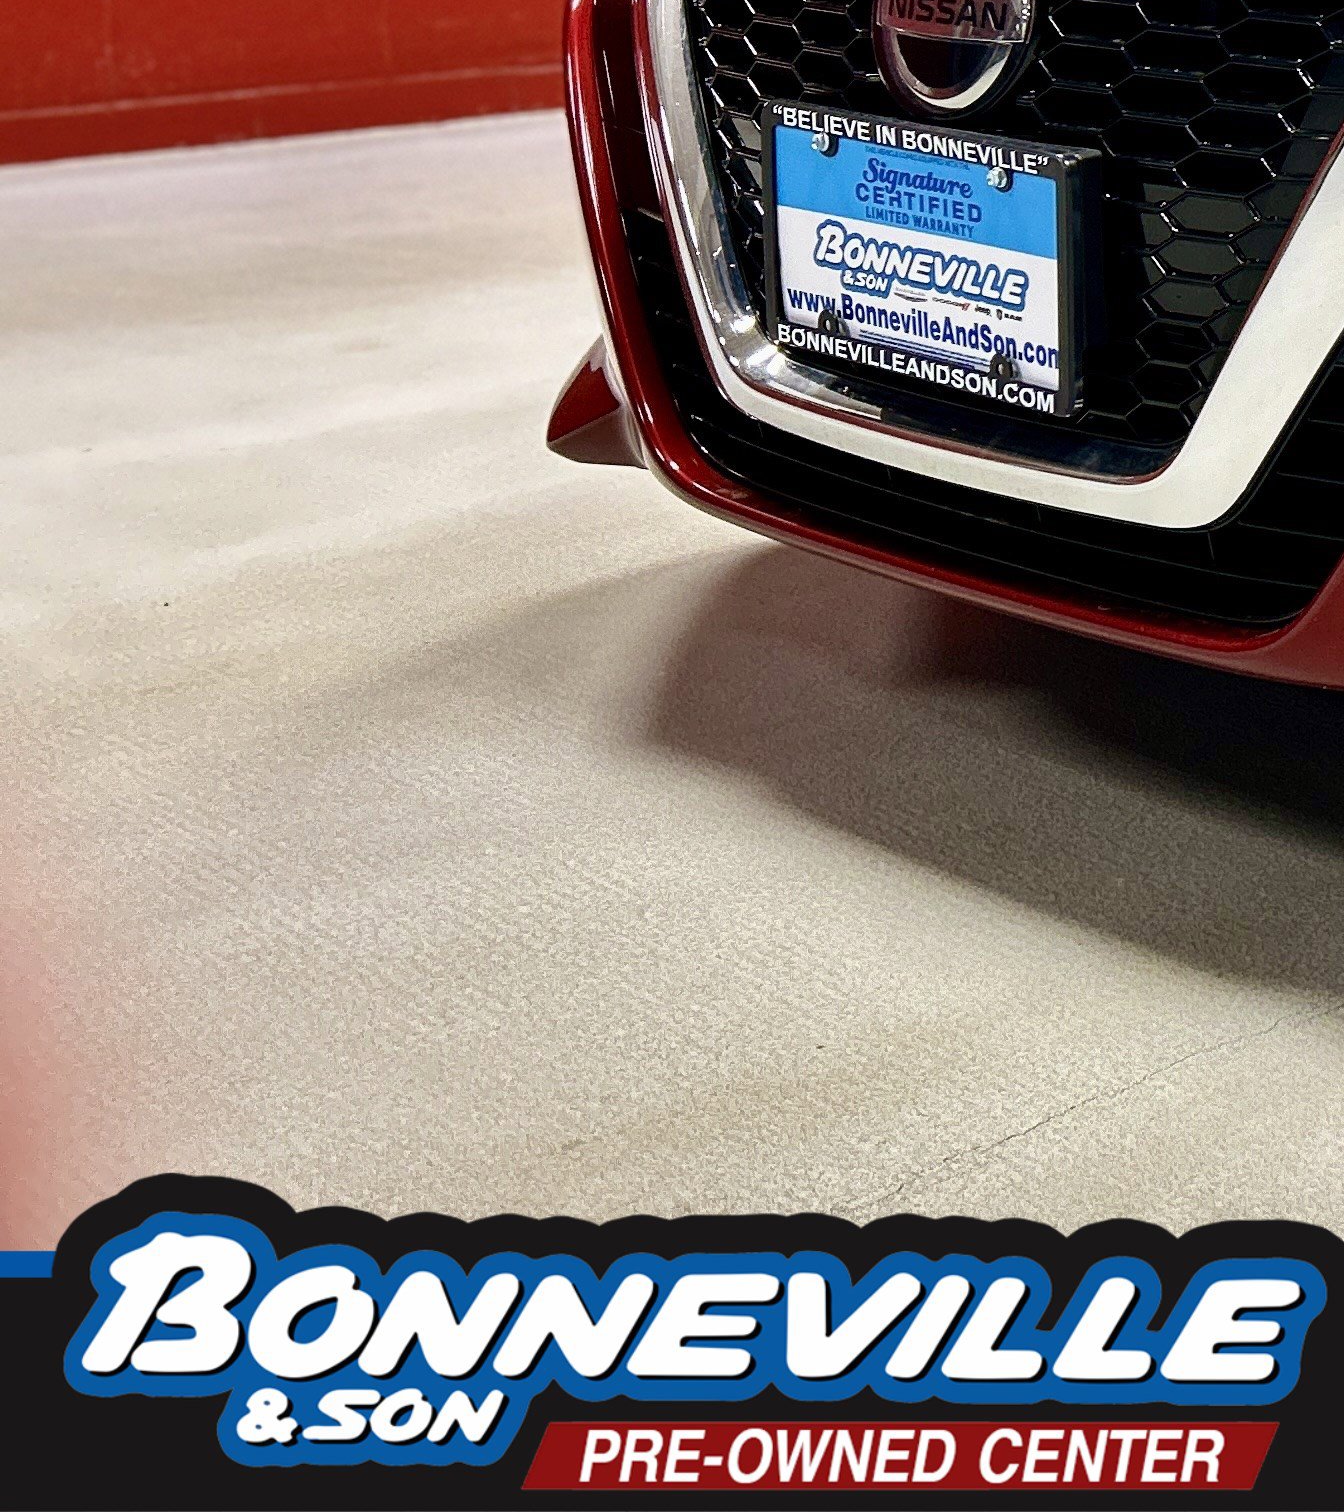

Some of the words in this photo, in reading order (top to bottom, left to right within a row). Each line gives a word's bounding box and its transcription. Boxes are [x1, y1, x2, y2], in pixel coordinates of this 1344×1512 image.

[875, 124, 896, 146] IN
[863, 157, 974, 199] Signature
[855, 182, 982, 223] CERTIFIED
[865, 205, 910, 226] LIMITED
[911, 214, 975, 239] WARRANTY
[814, 222, 1028, 306] BONNEVILLE
[777, 323, 1055, 415] BONNEVILLEANDSON.COM
